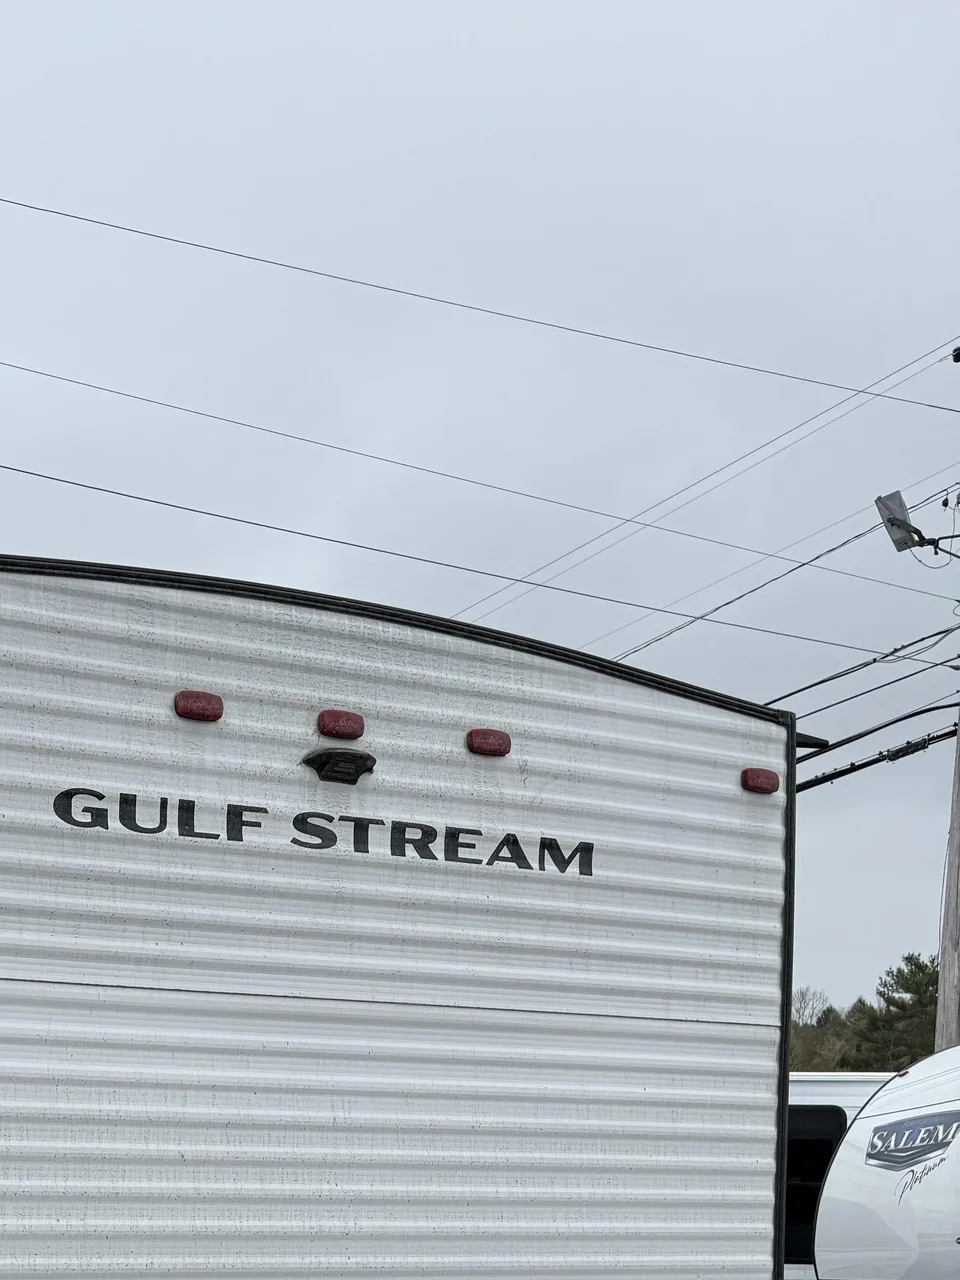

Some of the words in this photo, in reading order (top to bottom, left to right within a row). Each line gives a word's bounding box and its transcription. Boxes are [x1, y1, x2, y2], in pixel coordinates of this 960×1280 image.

[53, 787, 269, 842] GULF
[290, 811, 595, 876] STREAM
[867, 1121, 960, 1154] SALEM
[894, 1154, 949, 1205] Platinum
